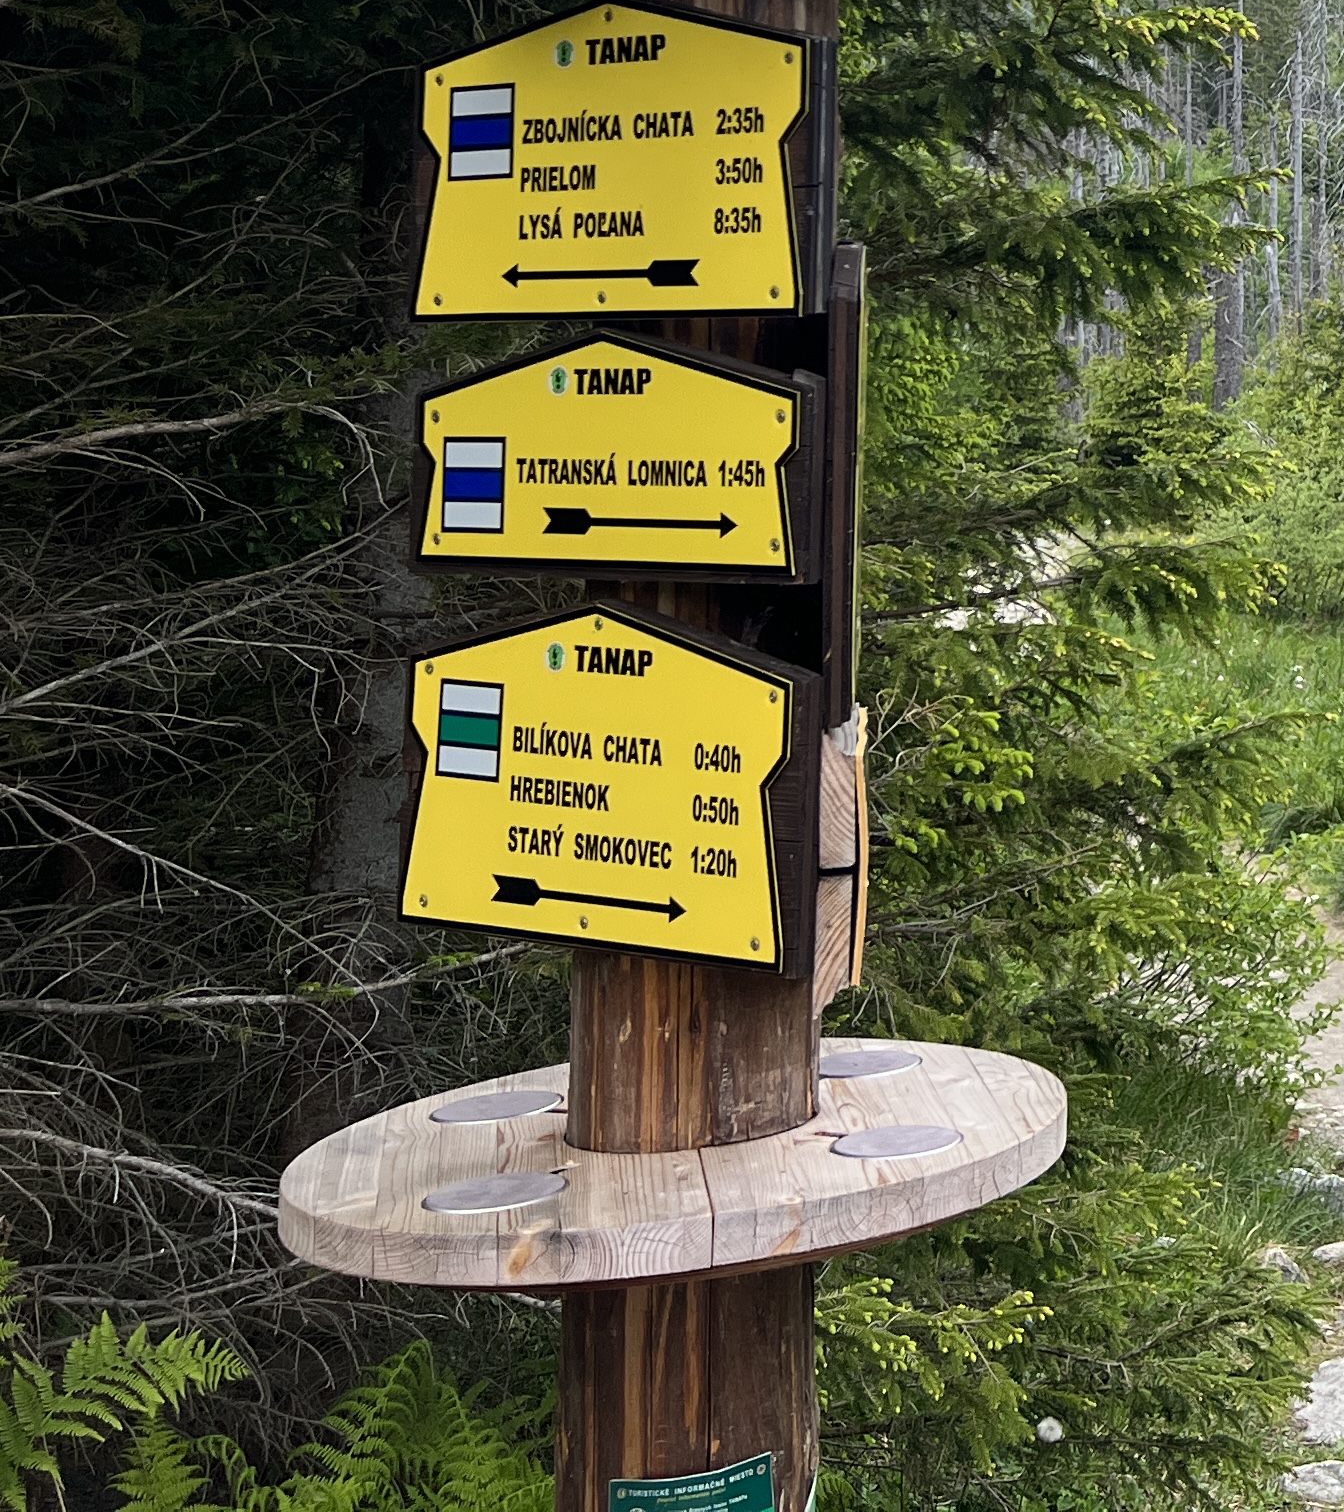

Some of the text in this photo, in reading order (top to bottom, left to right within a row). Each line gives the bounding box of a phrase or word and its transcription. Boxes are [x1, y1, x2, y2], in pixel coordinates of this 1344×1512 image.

[586, 34, 665, 65] TANAP
[522, 107, 764, 144] ZBOJNÍCKA CHATA 2:35h
[521, 157, 762, 192] PRIELOM 3:50h
[519, 207, 761, 240] LYSÁ POĽANA 8:35h
[574, 369, 651, 395] TANAP
[517, 453, 765, 487] TATRANSKÁ LOMNICA 1:45h
[575, 645, 652, 676] TANAP
[513, 722, 740, 773] BILÍKOVA CHATA 0:40h
[510, 775, 738, 825] HREBIENOK 0:50h
[508, 824, 736, 878] STARÝ SMOKOVEC 1:20h
